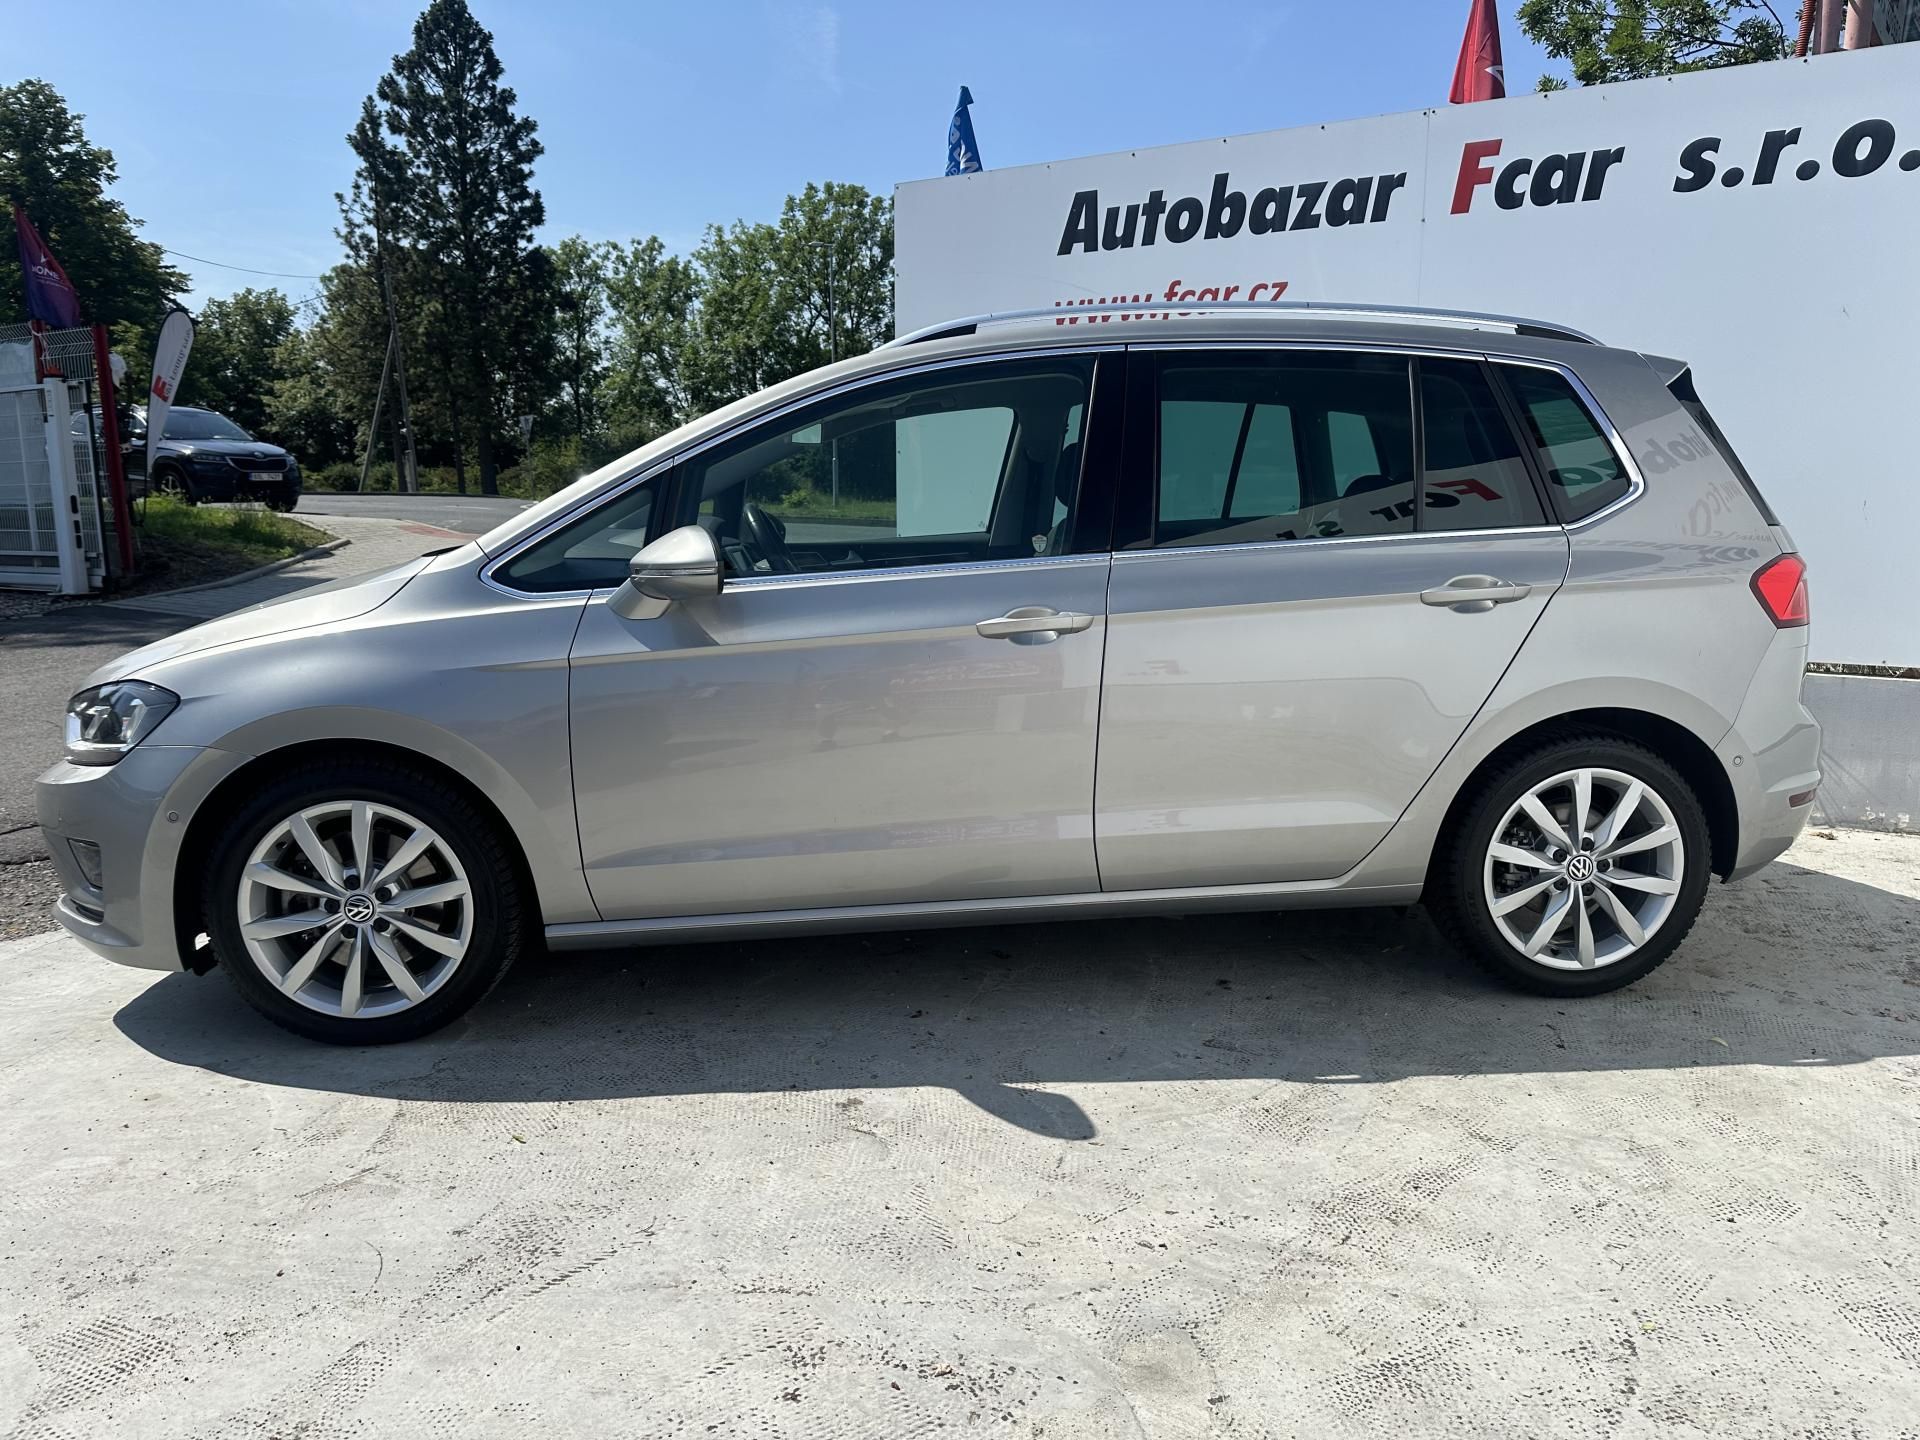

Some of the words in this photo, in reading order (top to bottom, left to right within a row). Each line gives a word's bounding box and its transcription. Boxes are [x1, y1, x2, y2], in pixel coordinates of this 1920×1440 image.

[1056, 171, 1407, 257] Autobazar
[1450, 138, 1626, 215] Fcar
[1672, 118, 1920, 193] s.r.o.
